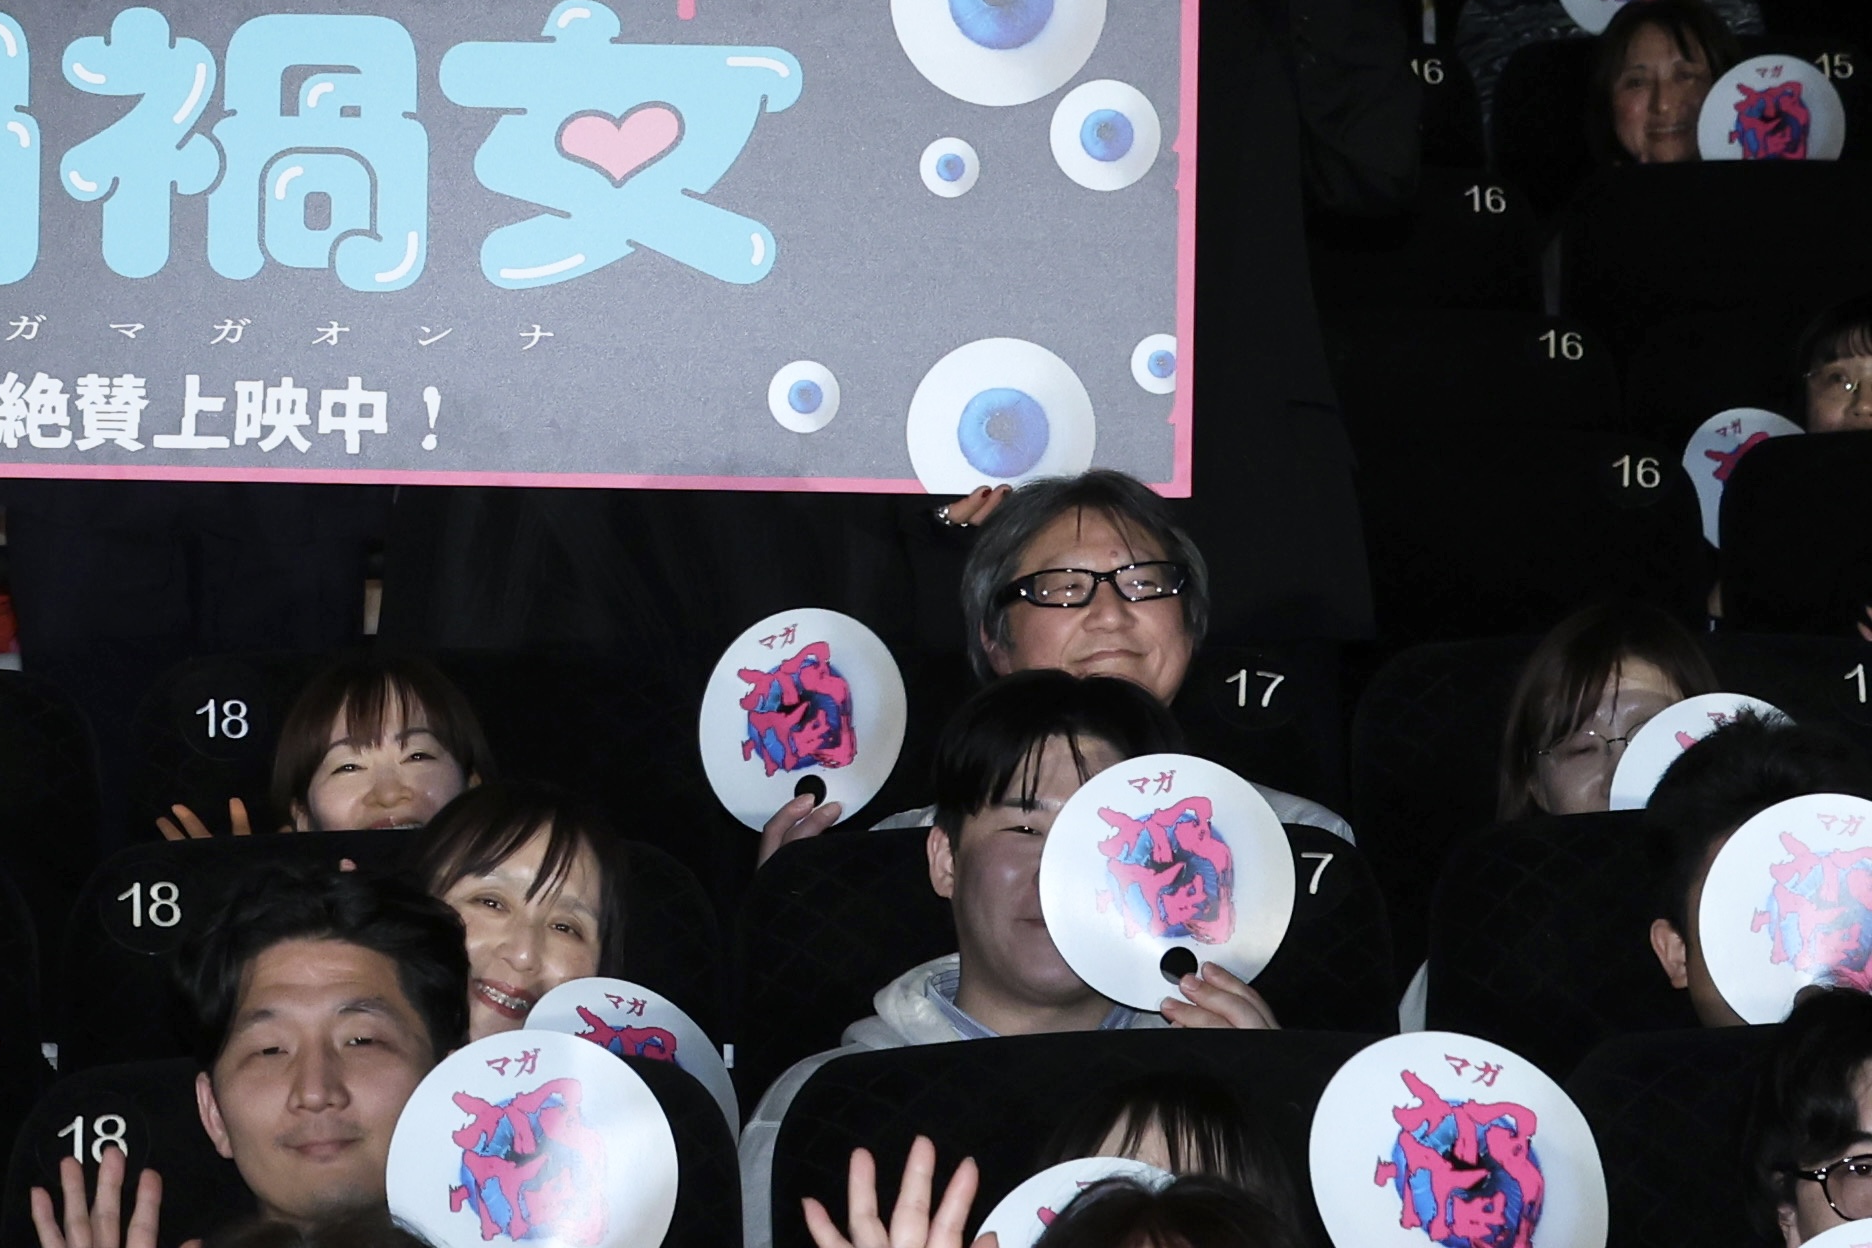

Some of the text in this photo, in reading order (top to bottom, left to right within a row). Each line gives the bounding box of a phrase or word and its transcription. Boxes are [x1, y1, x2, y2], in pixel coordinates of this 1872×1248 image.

[1815, 53, 1853, 80] 15
[1463, 184, 1507, 214] 16
[1537, 329, 1584, 361] 16
[1611, 454, 1661, 489] 16
[759, 624, 798, 649] マガ
[1224, 668, 1285, 708] 17
[1843, 663, 1867, 704] 1
[194, 698, 249, 739] 18
[1707, 711, 1740, 729] マ
[1128, 770, 1176, 795] マガ
[1817, 813, 1866, 837] マガ
[1298, 853, 1332, 895] 7
[116, 881, 182, 928] 18
[605, 994, 647, 1016] マガ
[486, 1048, 540, 1077] マガ
[1445, 1054, 1503, 1087] マガ
[56, 1114, 129, 1166] 18
